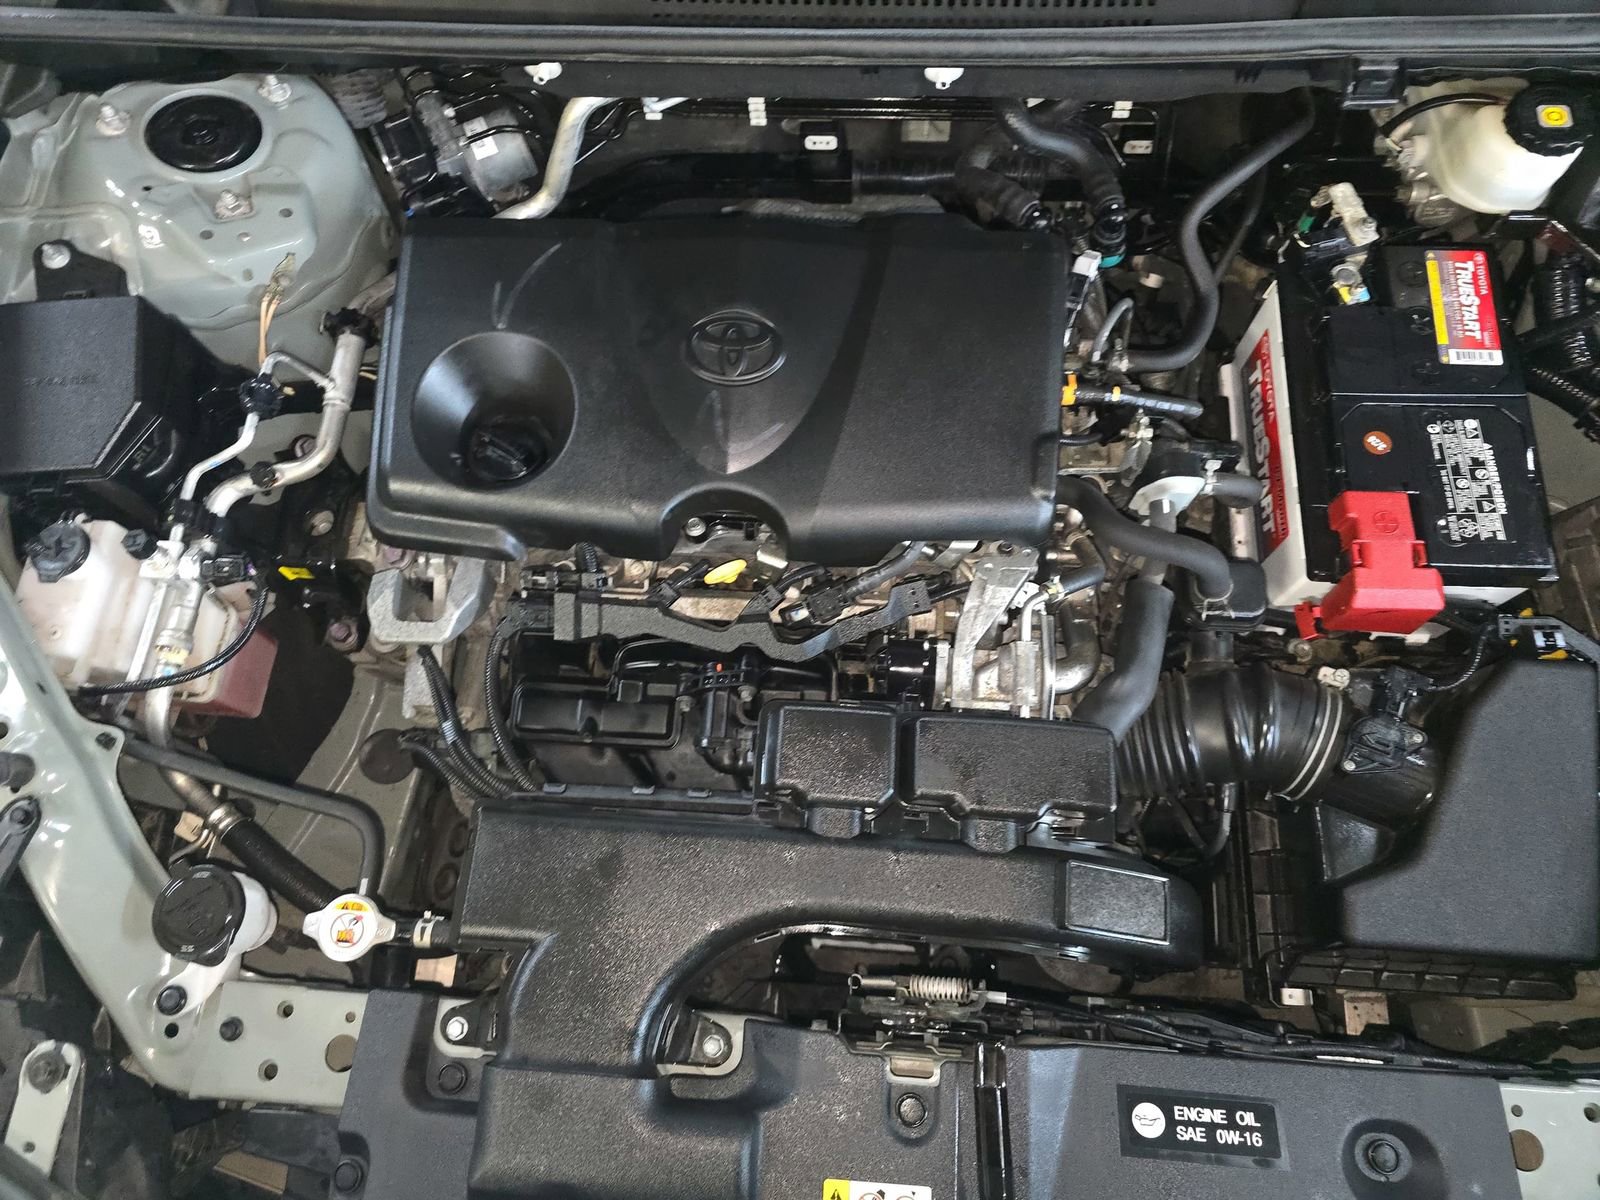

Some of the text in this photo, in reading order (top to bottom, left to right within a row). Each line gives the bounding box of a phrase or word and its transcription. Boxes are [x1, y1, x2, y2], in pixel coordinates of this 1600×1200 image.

[1476, 265, 1488, 295] TOYOTA
[1174, 1105, 1261, 1127] ENGINE OIL
[1176, 1126, 1263, 1147] SAE 0W-16
